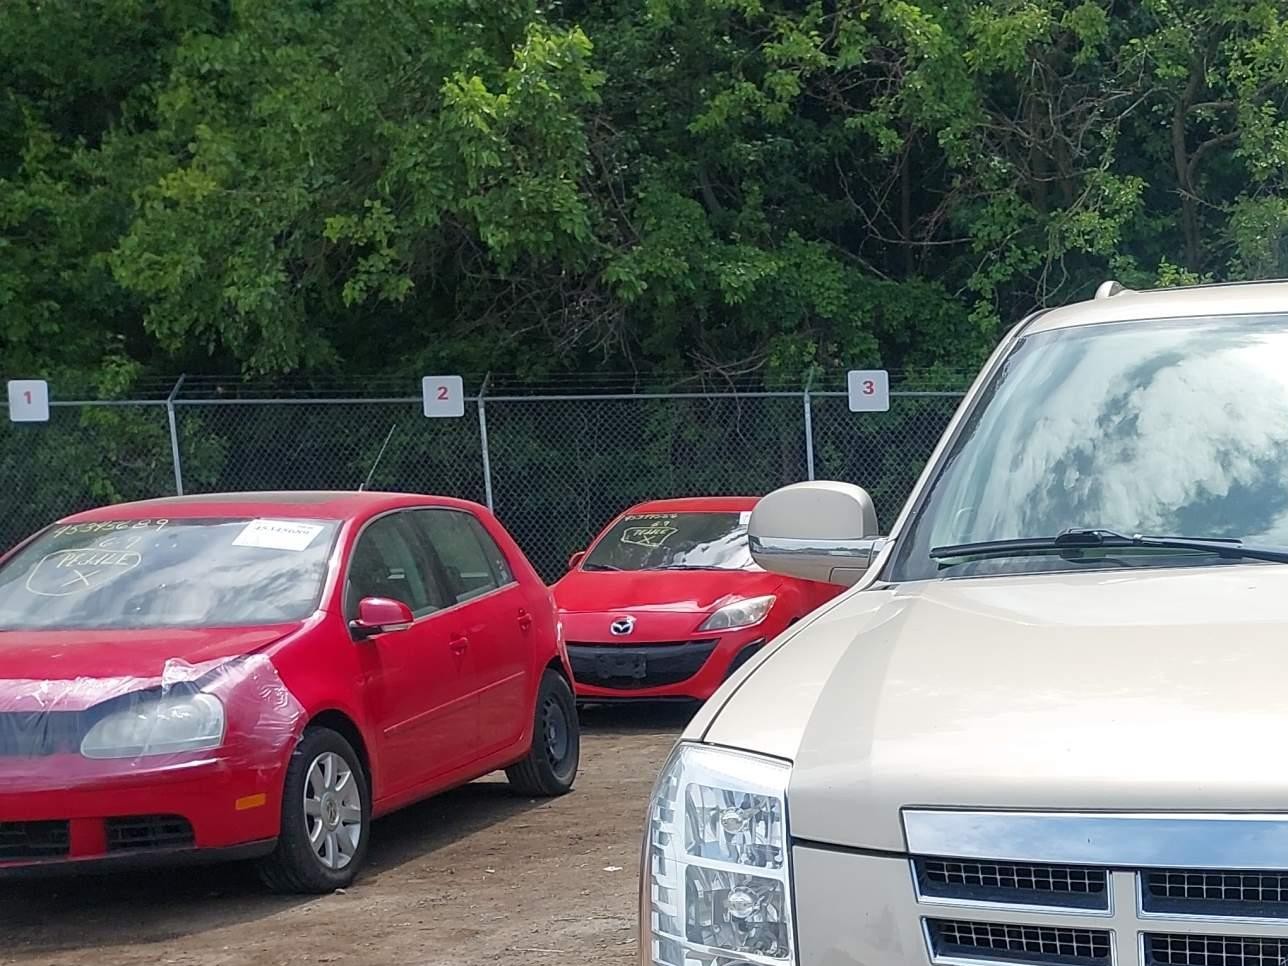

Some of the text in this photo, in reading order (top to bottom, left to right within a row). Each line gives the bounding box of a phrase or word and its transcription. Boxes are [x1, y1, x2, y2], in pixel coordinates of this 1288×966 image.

[438, 386, 448, 400] 2
[863, 380, 874, 394] 3
[24, 391, 31, 404] 1
